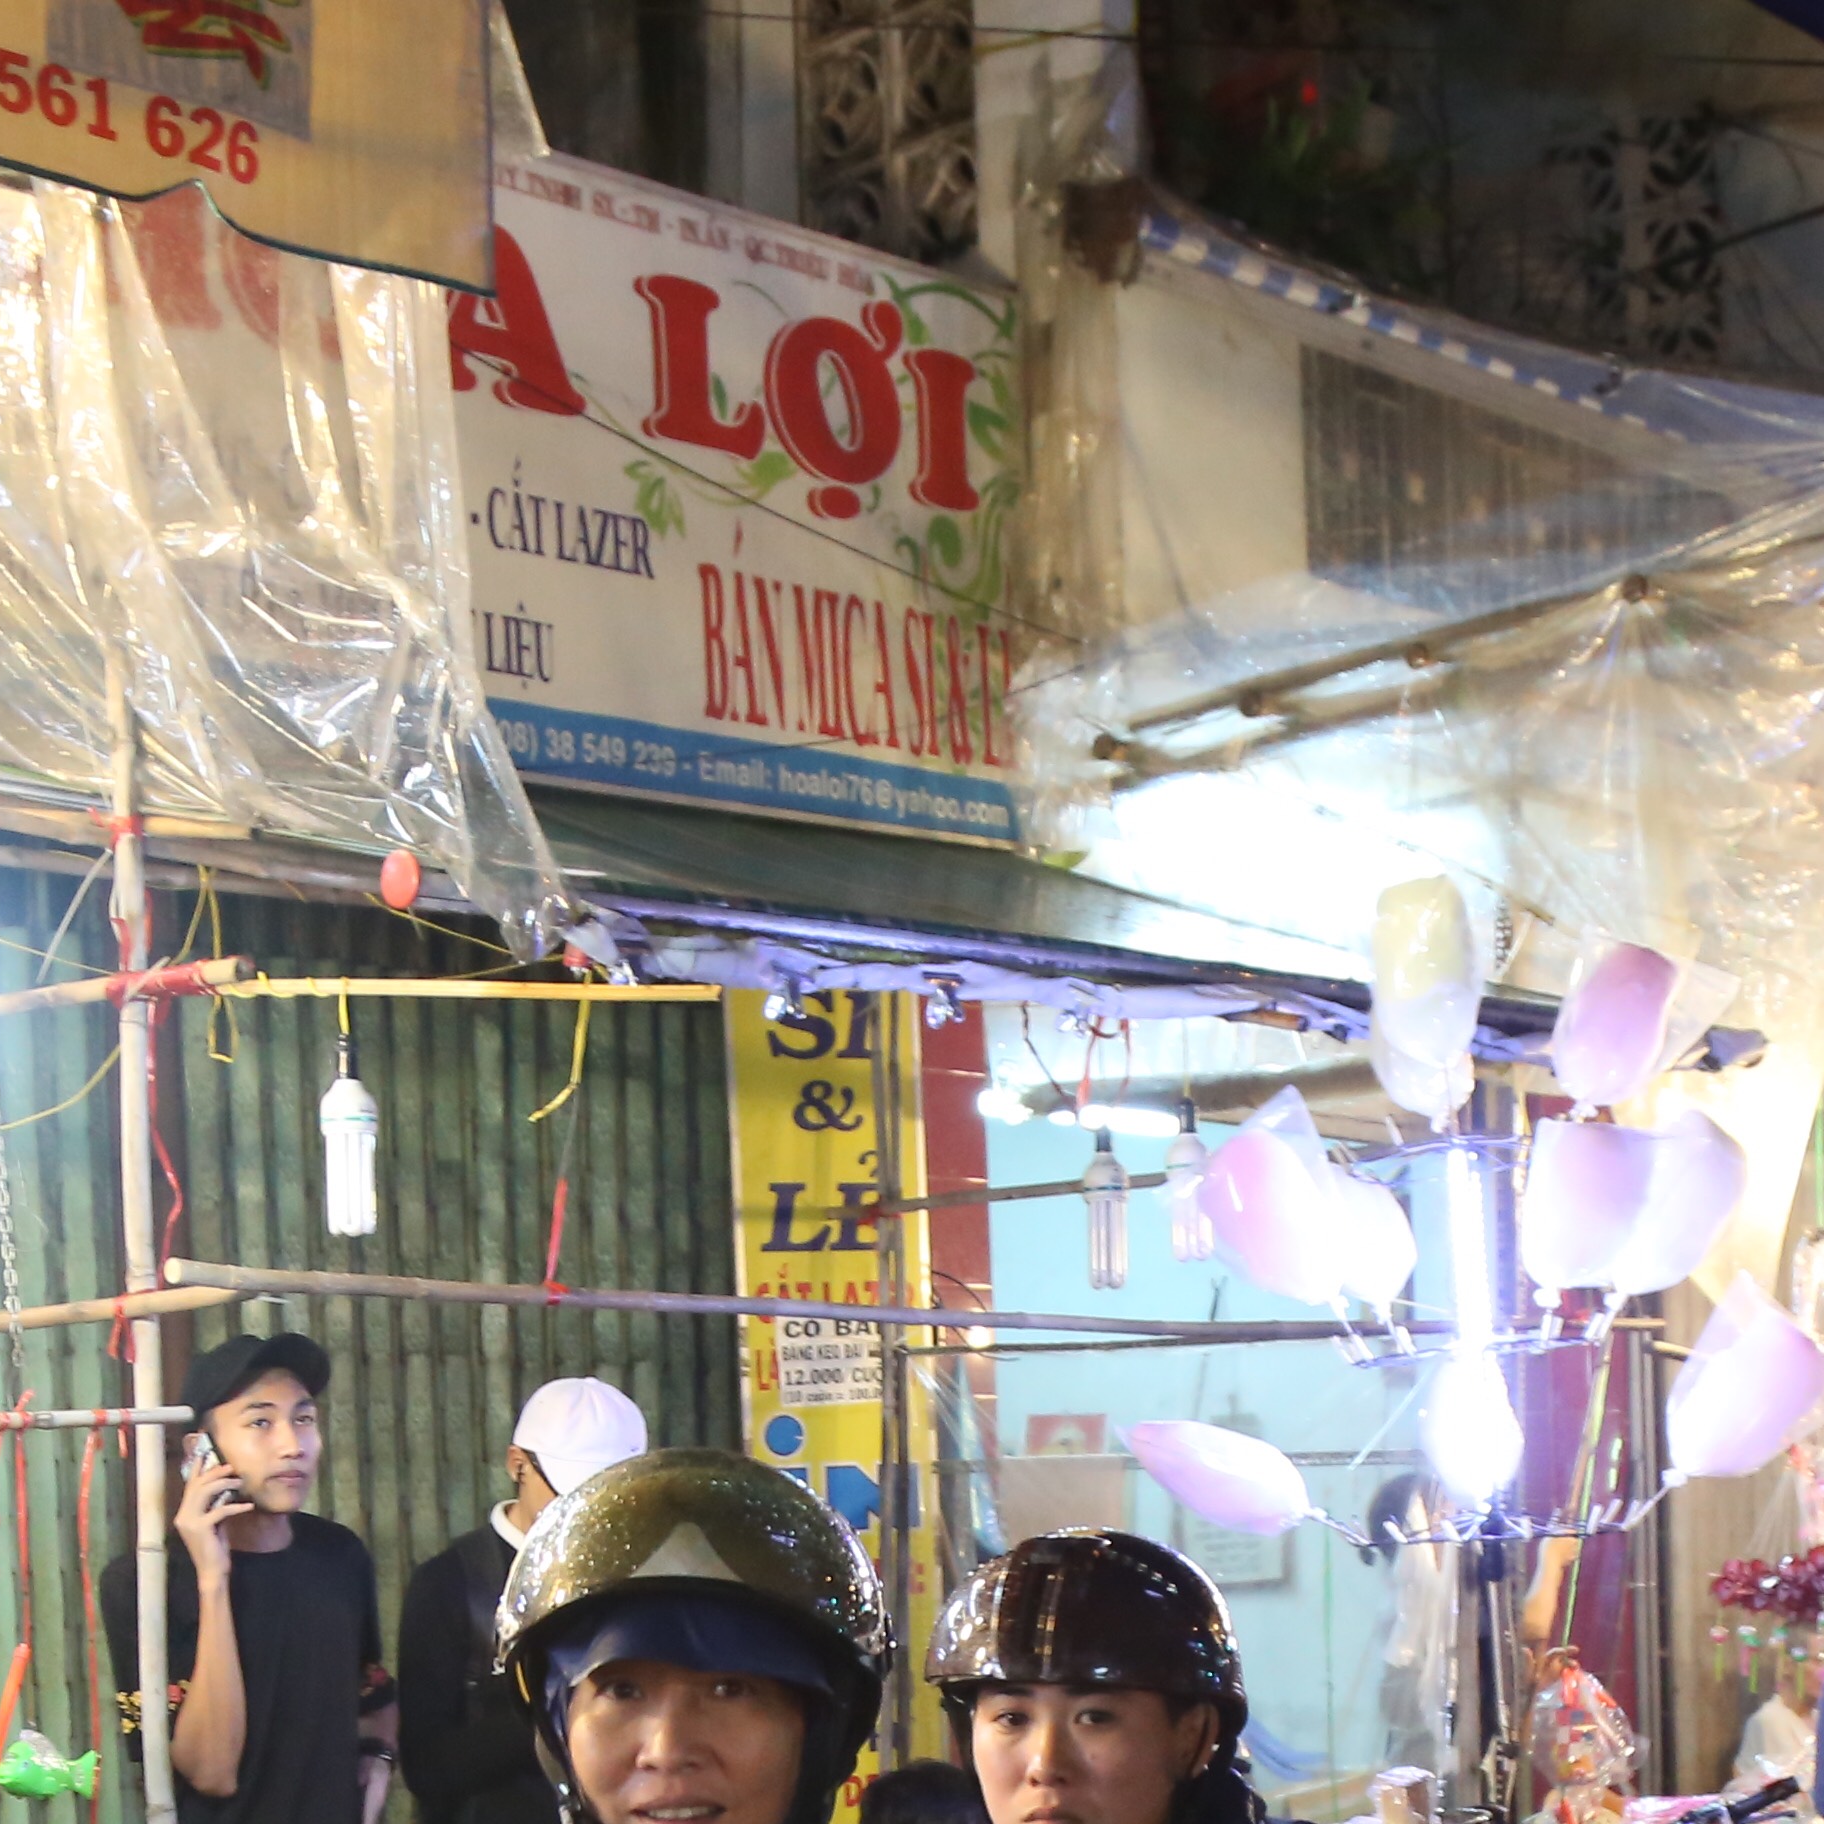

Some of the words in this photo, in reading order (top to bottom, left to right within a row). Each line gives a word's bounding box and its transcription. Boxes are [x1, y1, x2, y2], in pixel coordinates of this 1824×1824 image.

[144, 94, 261, 186] 626
[634, 274, 979, 520] LỢI
[553, 498, 656, 580] LAZER
[483, 600, 555, 690] LIỆU
[698, 518, 789, 736] BÁN
[793, 583, 906, 754] MICA
[546, 726, 579, 764] 38
[583, 730, 629, 769] 549
[697, 750, 773, 793] Email:
[792, 1079, 865, 1132] &
